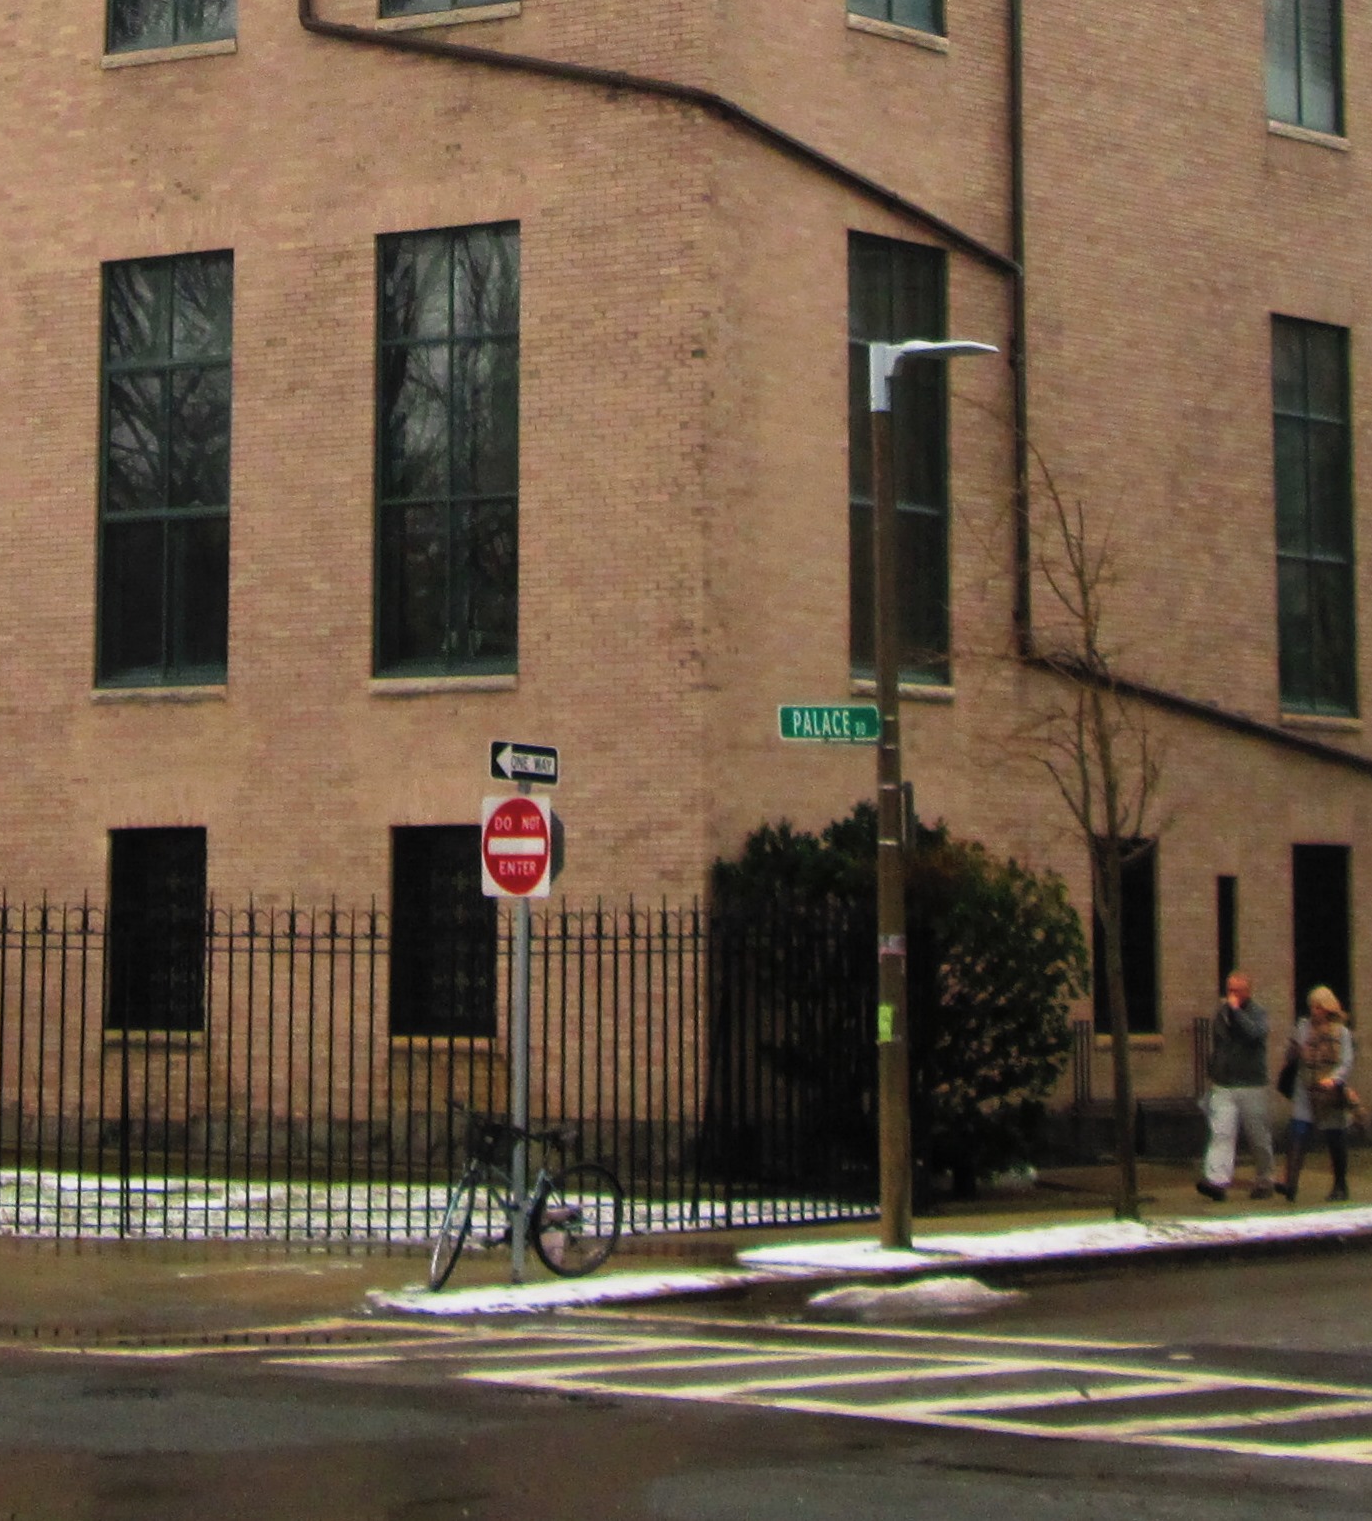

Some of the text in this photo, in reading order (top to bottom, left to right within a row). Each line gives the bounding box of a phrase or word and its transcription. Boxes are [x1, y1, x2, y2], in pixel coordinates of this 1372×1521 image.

[792, 709, 852, 736] PALACE
[511, 754, 553, 772] ONE WAY
[494, 815, 541, 831] DO NOT
[498, 860, 537, 876] ENTER
